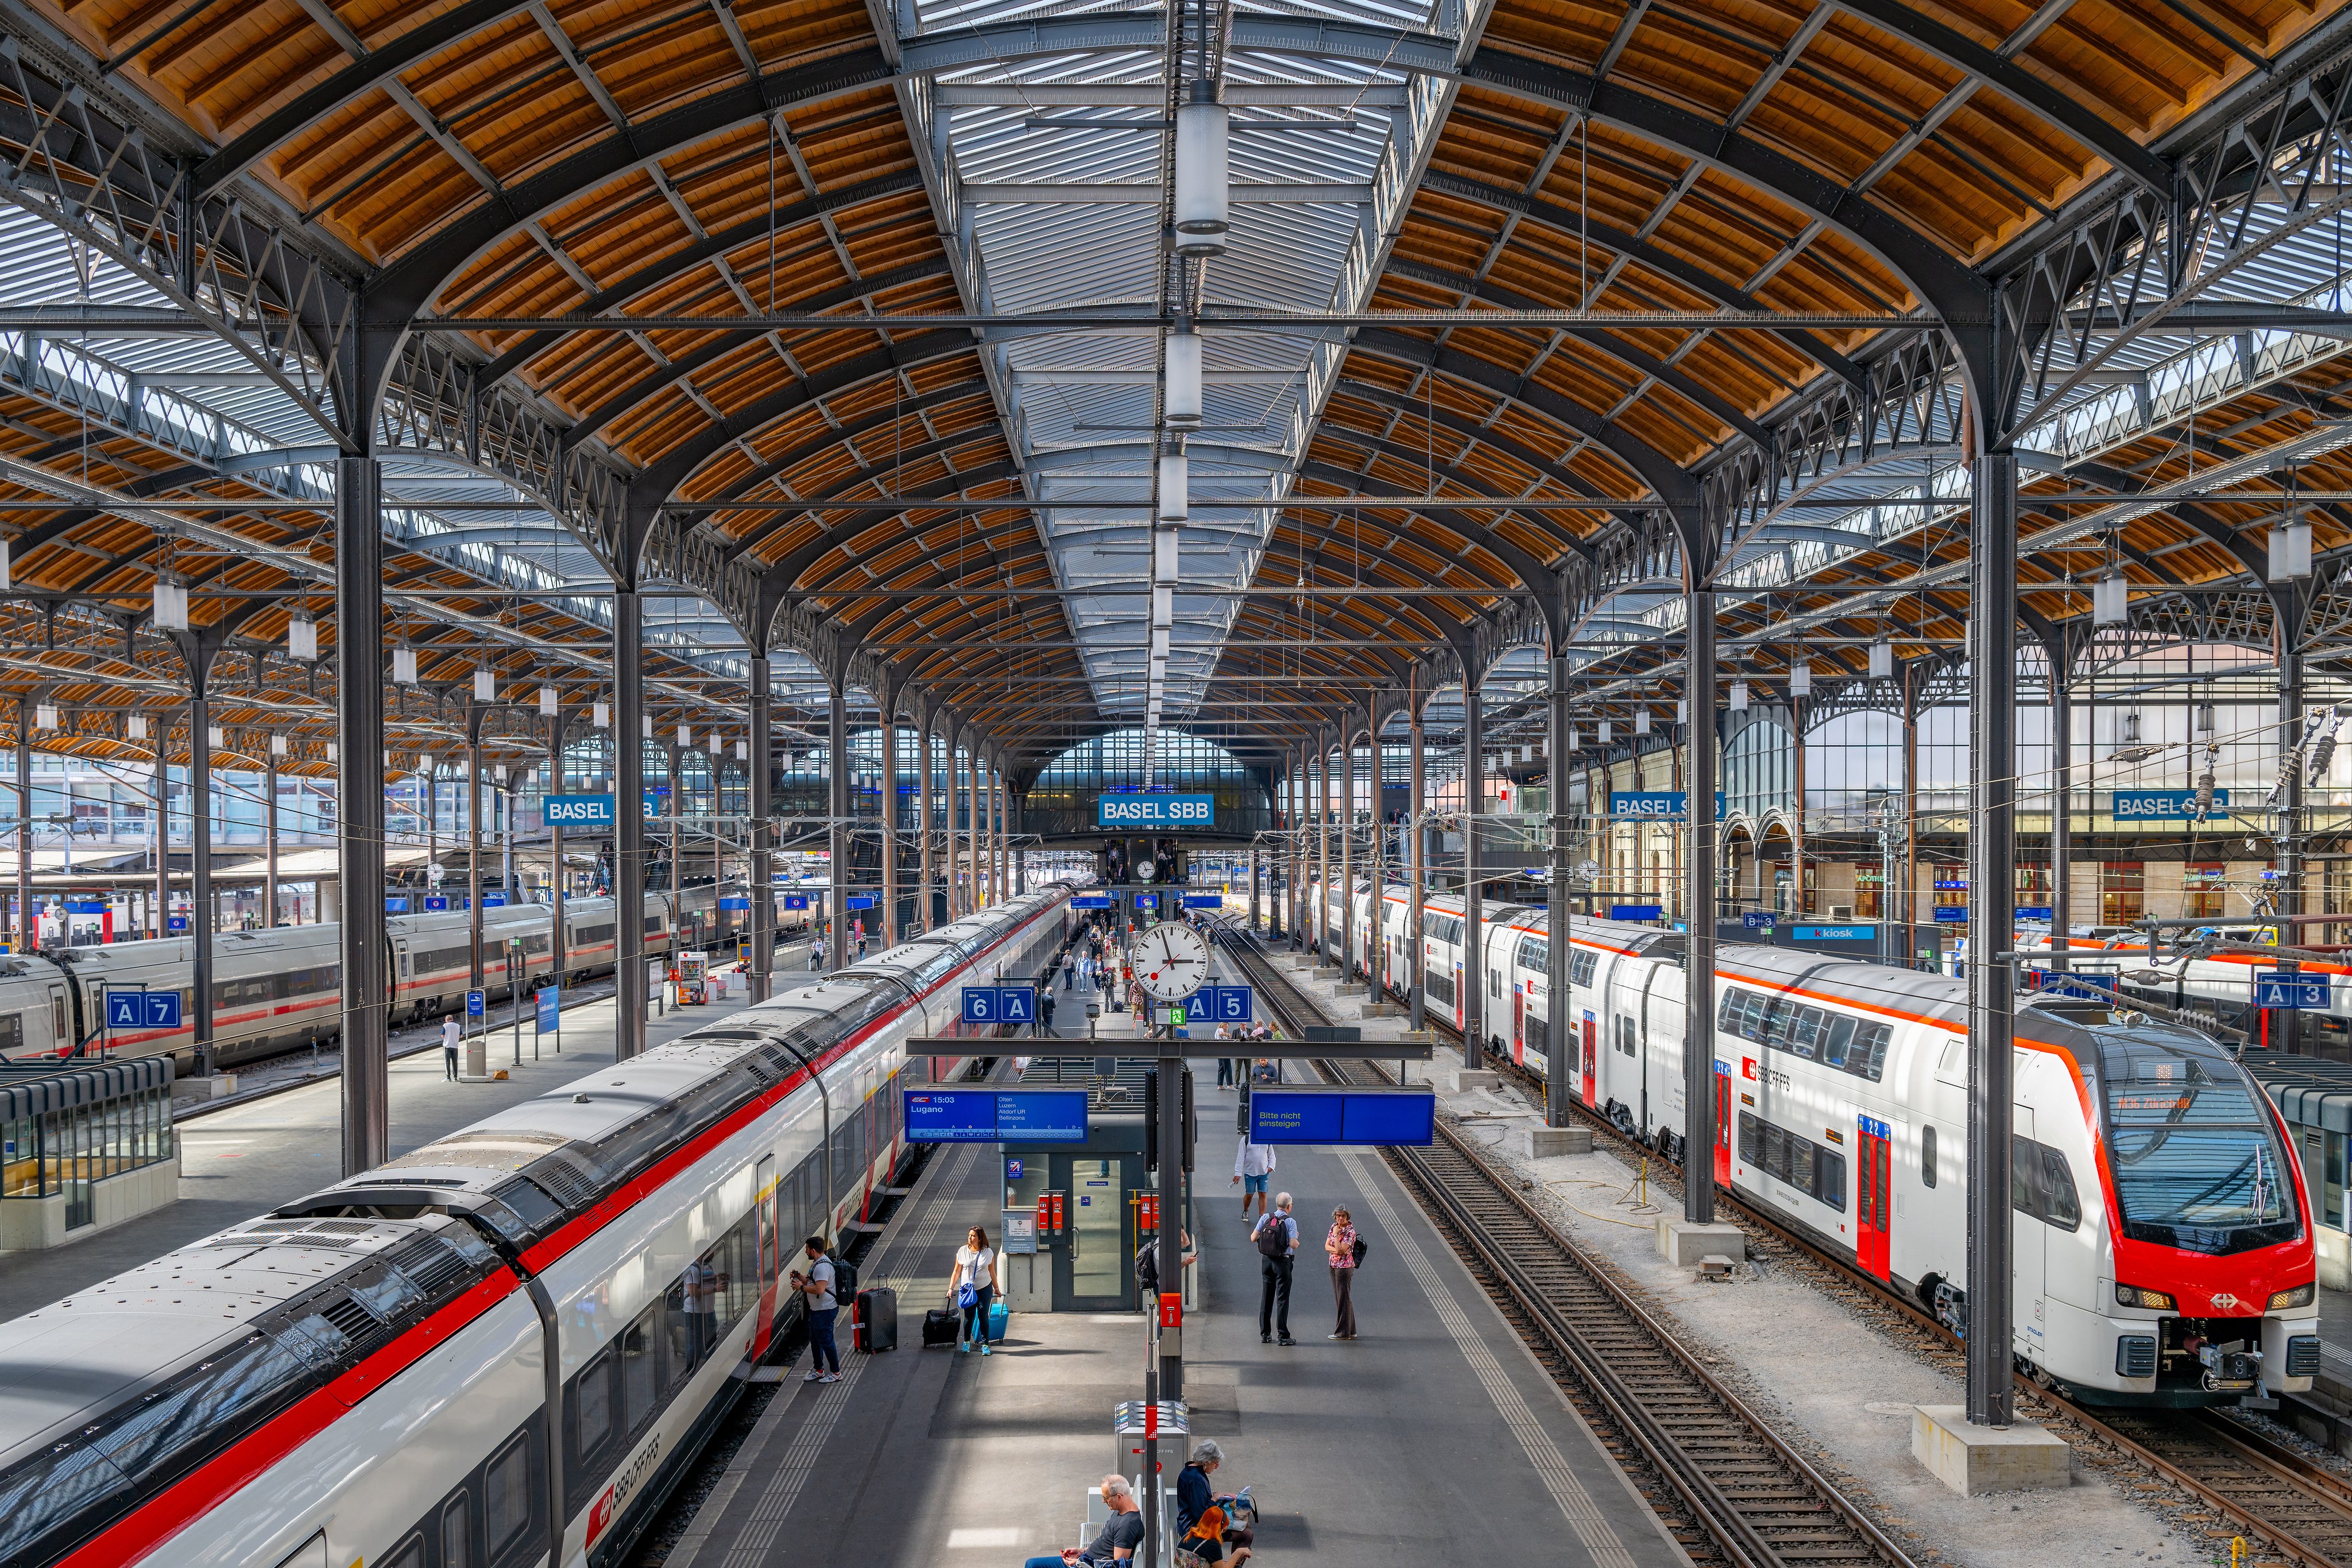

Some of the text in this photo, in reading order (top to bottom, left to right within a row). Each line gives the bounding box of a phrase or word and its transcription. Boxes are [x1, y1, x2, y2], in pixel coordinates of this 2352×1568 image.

[550, 803, 610, 819] BASEL
[1104, 803, 1209, 819] BASEL SBB
[2119, 797, 2180, 815] BASEL
[1748, 917, 1756, 926] B
[1765, 917, 1772, 926] 3
[1823, 928, 1853, 938] kiosk
[2268, 984, 2284, 1002] A
[2305, 985, 2320, 1002] 3
[117, 1004, 133, 1021] A
[155, 1004, 168, 1021] 7
[973, 999, 987, 1017] 6
[1009, 999, 1024, 1016] A
[1189, 998, 1205, 1016] A
[1227, 998, 1240, 1016] 5
[15, 1017, 20, 1031] 2
[1717, 1062, 1724, 1074] 2 2
[1758, 1065, 1790, 1092] SBB CFF FFS
[911, 1106, 943, 1114] Lugano
[2144, 1098, 2175, 1109] Zürich
[2177, 1098, 2189, 1109] HB
[1259, 1120, 1301, 1129] einsteigen
[1869, 1120, 1878, 1136] 2 2
[2027, 1326, 2042, 1337] STADLER
[613, 1433, 660, 1510] SBB CFF FFS
